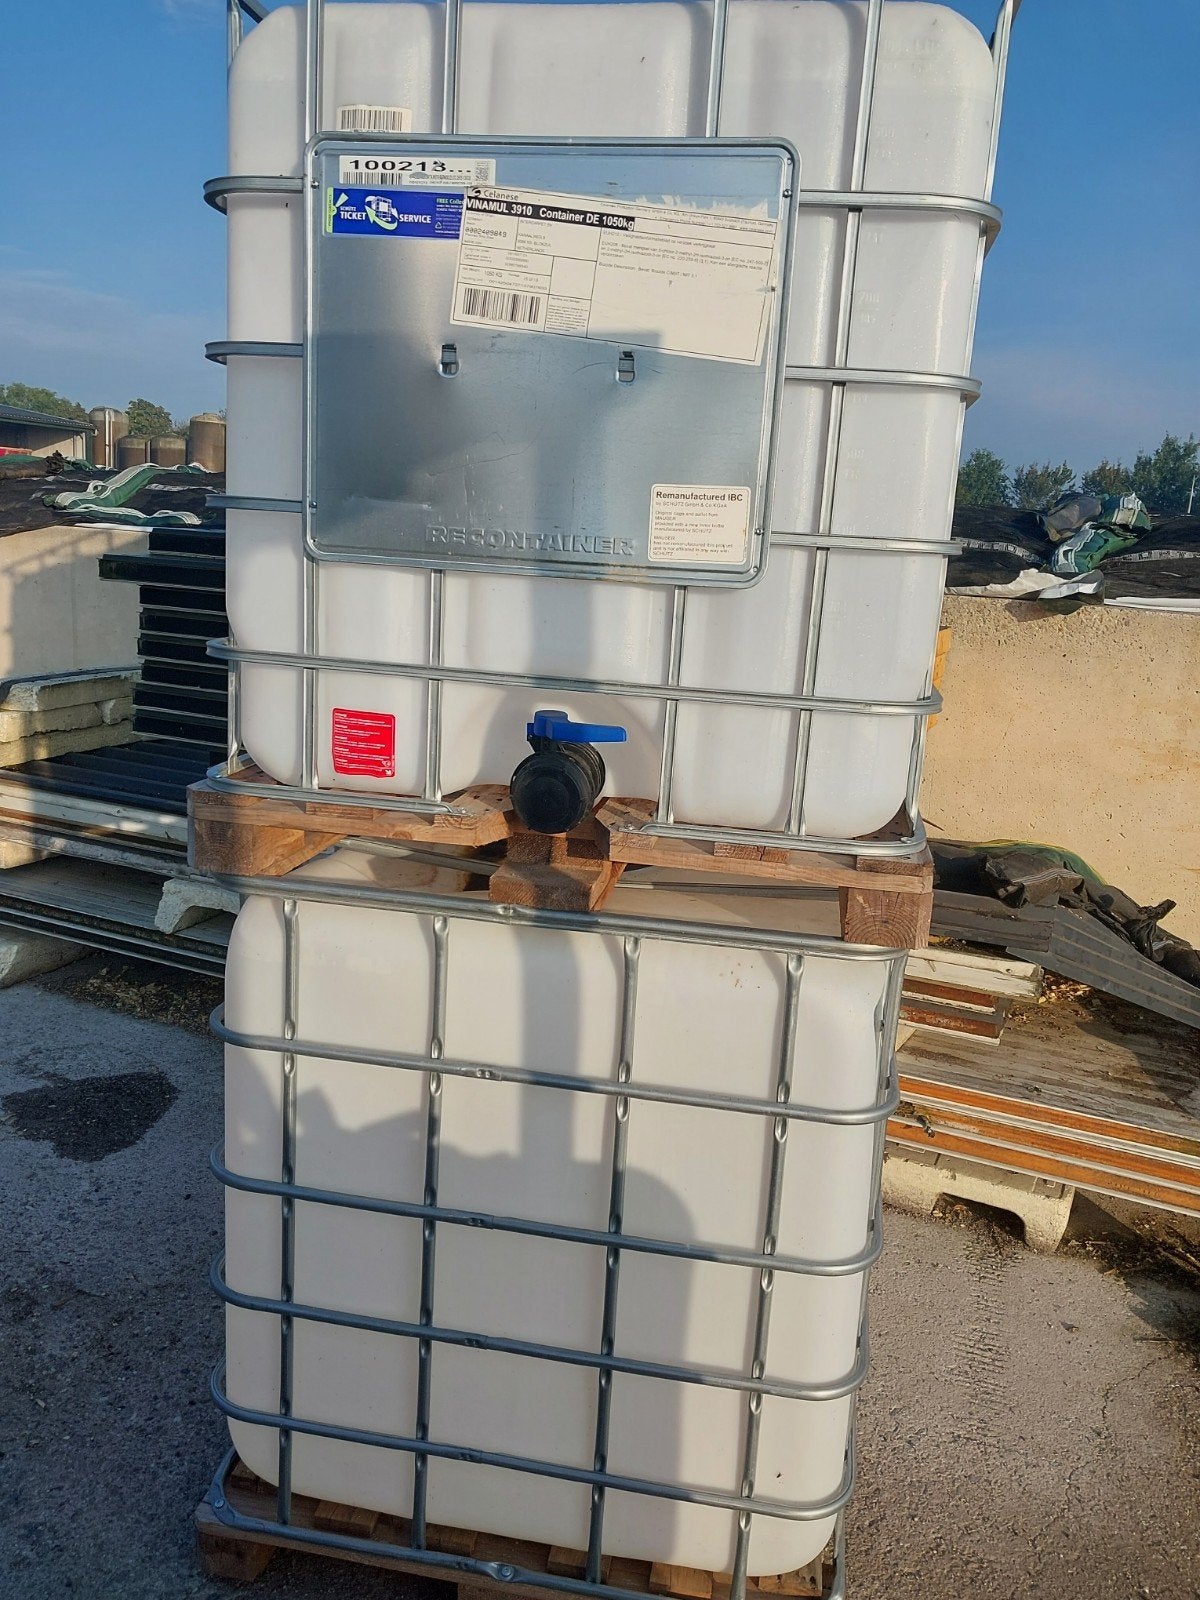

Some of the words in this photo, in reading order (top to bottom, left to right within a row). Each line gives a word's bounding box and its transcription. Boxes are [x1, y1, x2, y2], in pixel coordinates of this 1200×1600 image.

[483, 189, 519, 201] Celanese
[340, 211, 367, 220] TICKET
[399, 214, 432, 223] SERVICE
[467, 198, 509, 213] VINAMUL
[511, 203, 533, 216] 3910
[539, 208, 585, 225] Container
[586, 213, 600, 225] DE
[602, 215, 635, 231] 1050kg
[656, 491, 726, 501] Remanufactured
[728, 493, 743, 502] IBC
[425, 525, 635, 556] RECONTAINER
